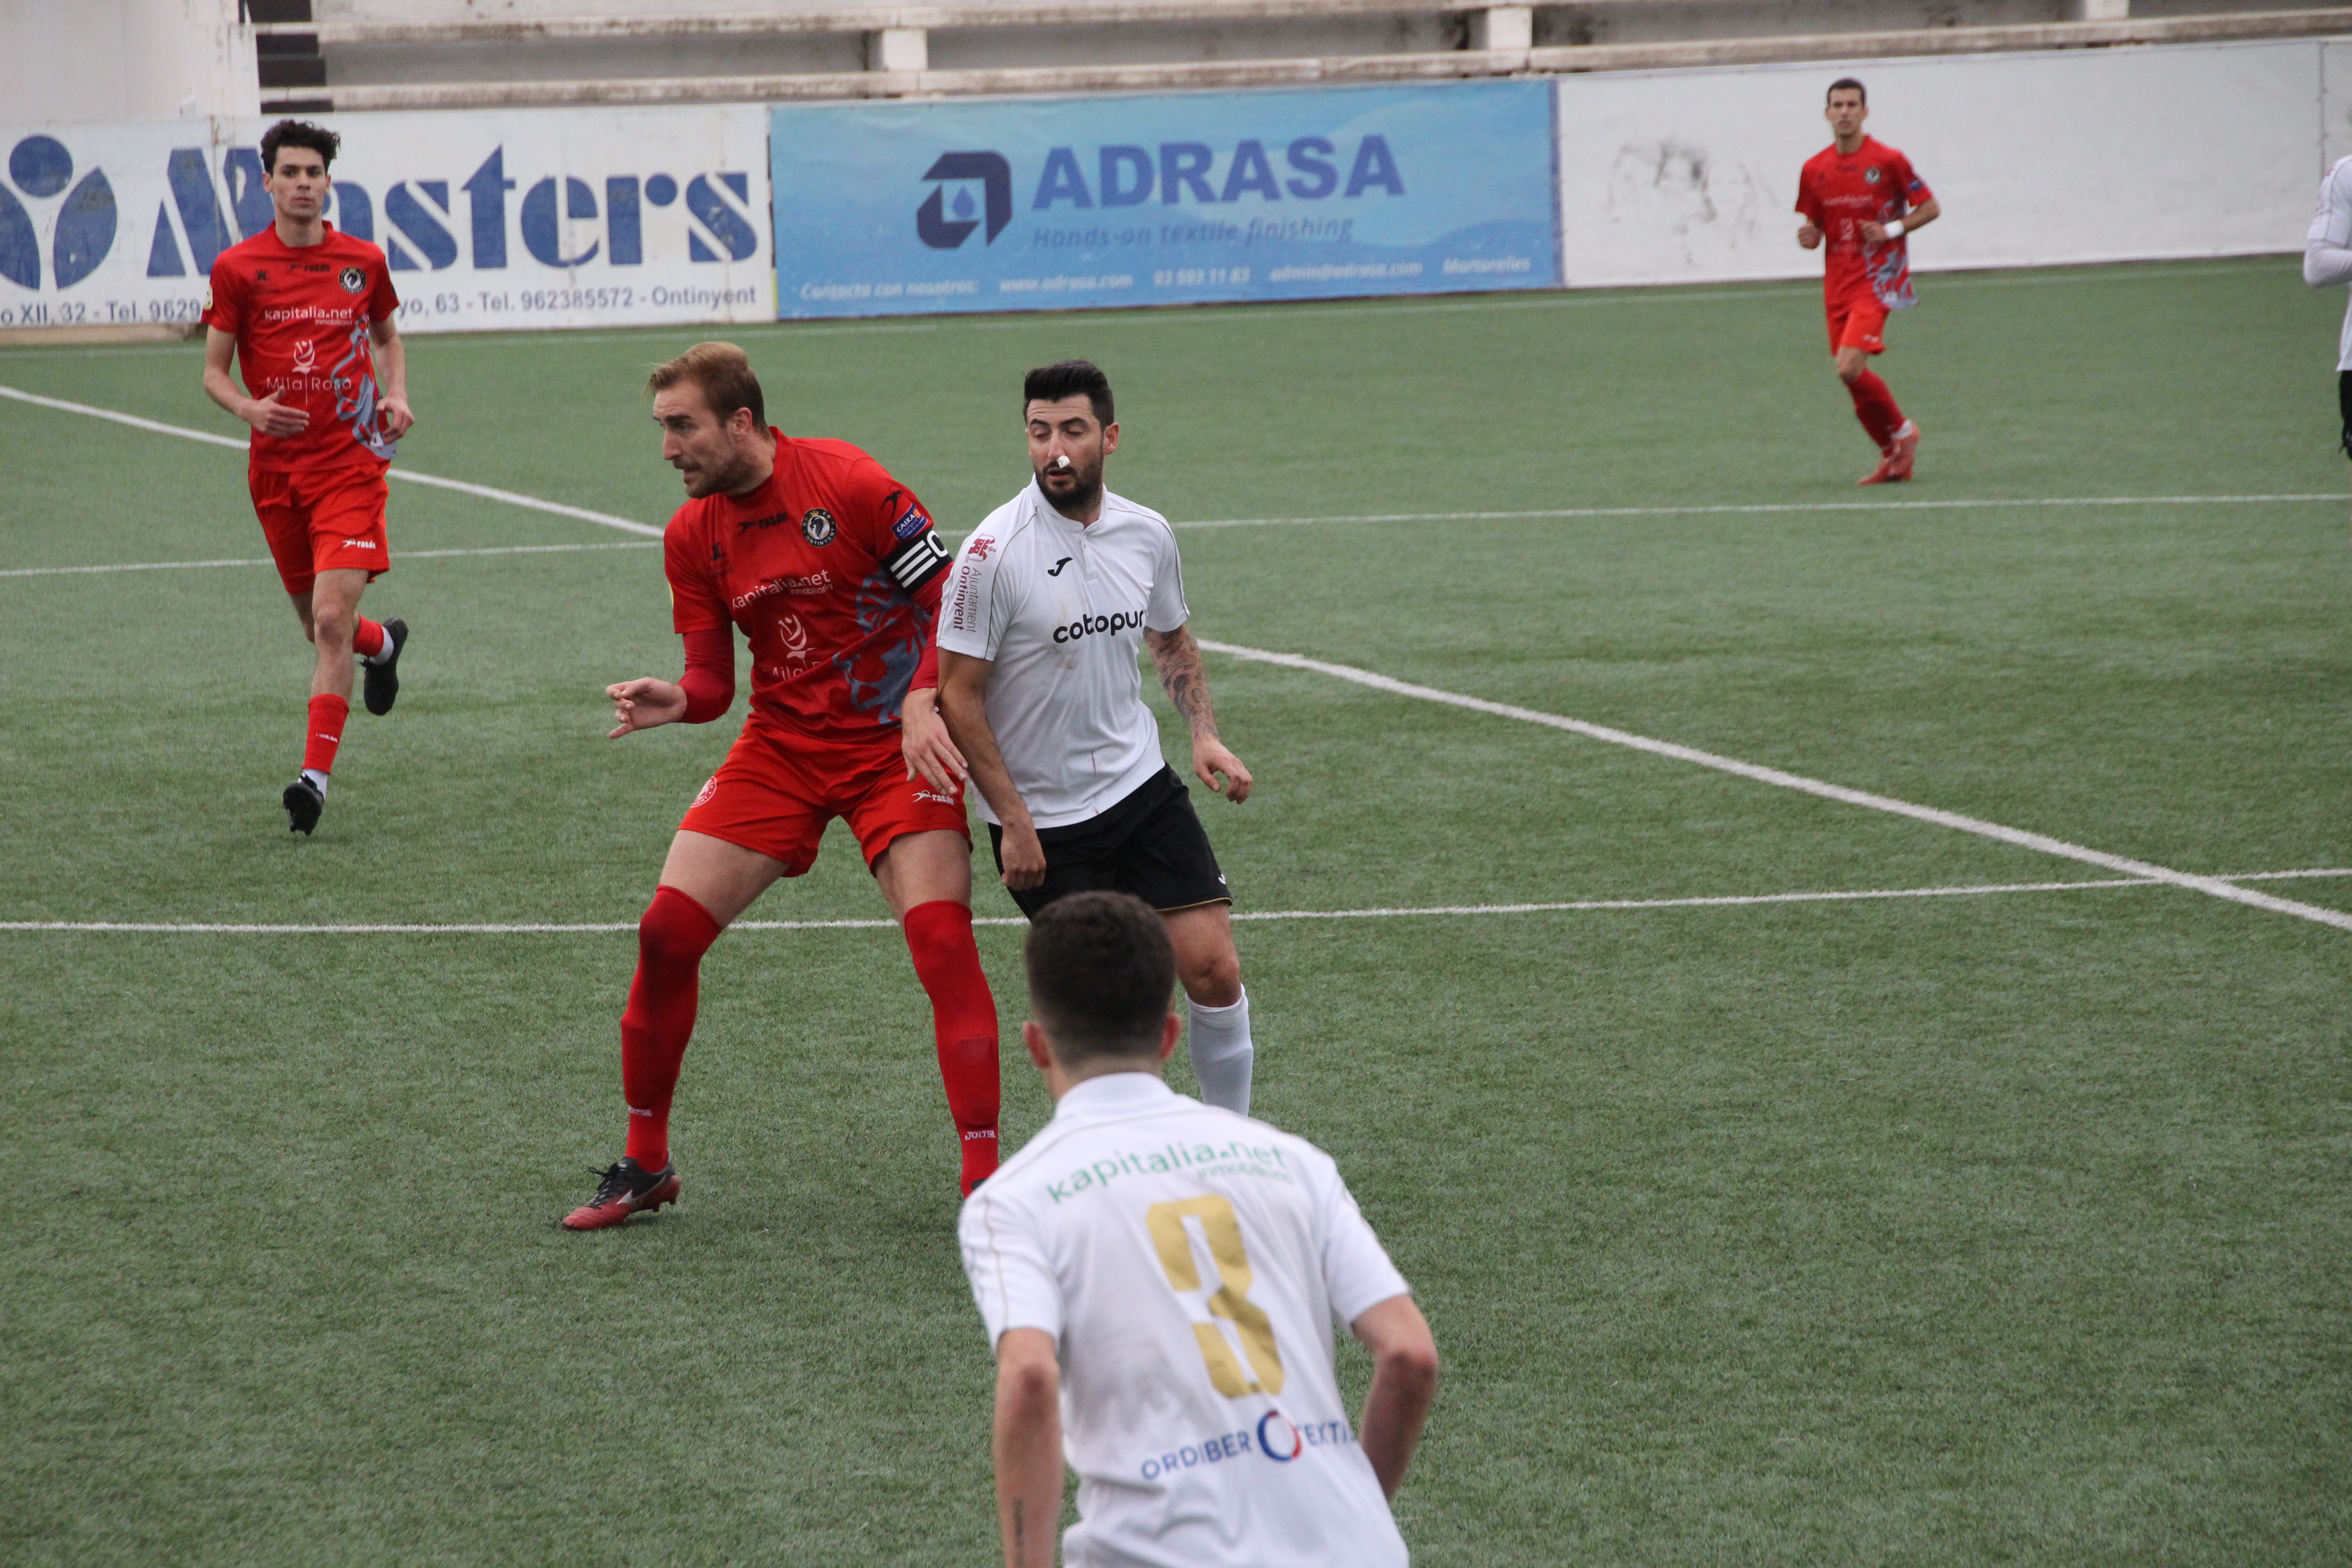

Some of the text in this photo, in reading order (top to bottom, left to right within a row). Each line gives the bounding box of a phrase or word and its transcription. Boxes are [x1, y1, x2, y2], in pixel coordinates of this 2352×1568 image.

[1032, 134, 1406, 211] ADRASA
[1032, 215, 1355, 248] Hands-on textile finishing
[59, 301, 86, 323] 32
[435, 293, 461, 313] 63
[477, 290, 515, 312] Tel.
[521, 286, 634, 312] 962385572
[652, 284, 756, 310] Ontinyent
[267, 376, 352, 391] Mila Rosa
[806, 528, 835, 545] ONTINYENT
[897, 514, 916, 532] CAIXA
[899, 518, 918, 536] Ontinyent
[965, 568, 982, 633] Ajuntament
[1053, 609, 1145, 643] cotopur
[1046, 1141, 1288, 1205] kapitalia.net
[1144, 1192, 1286, 1401] 3
[1141, 1430, 1252, 1480] ORDIBER
